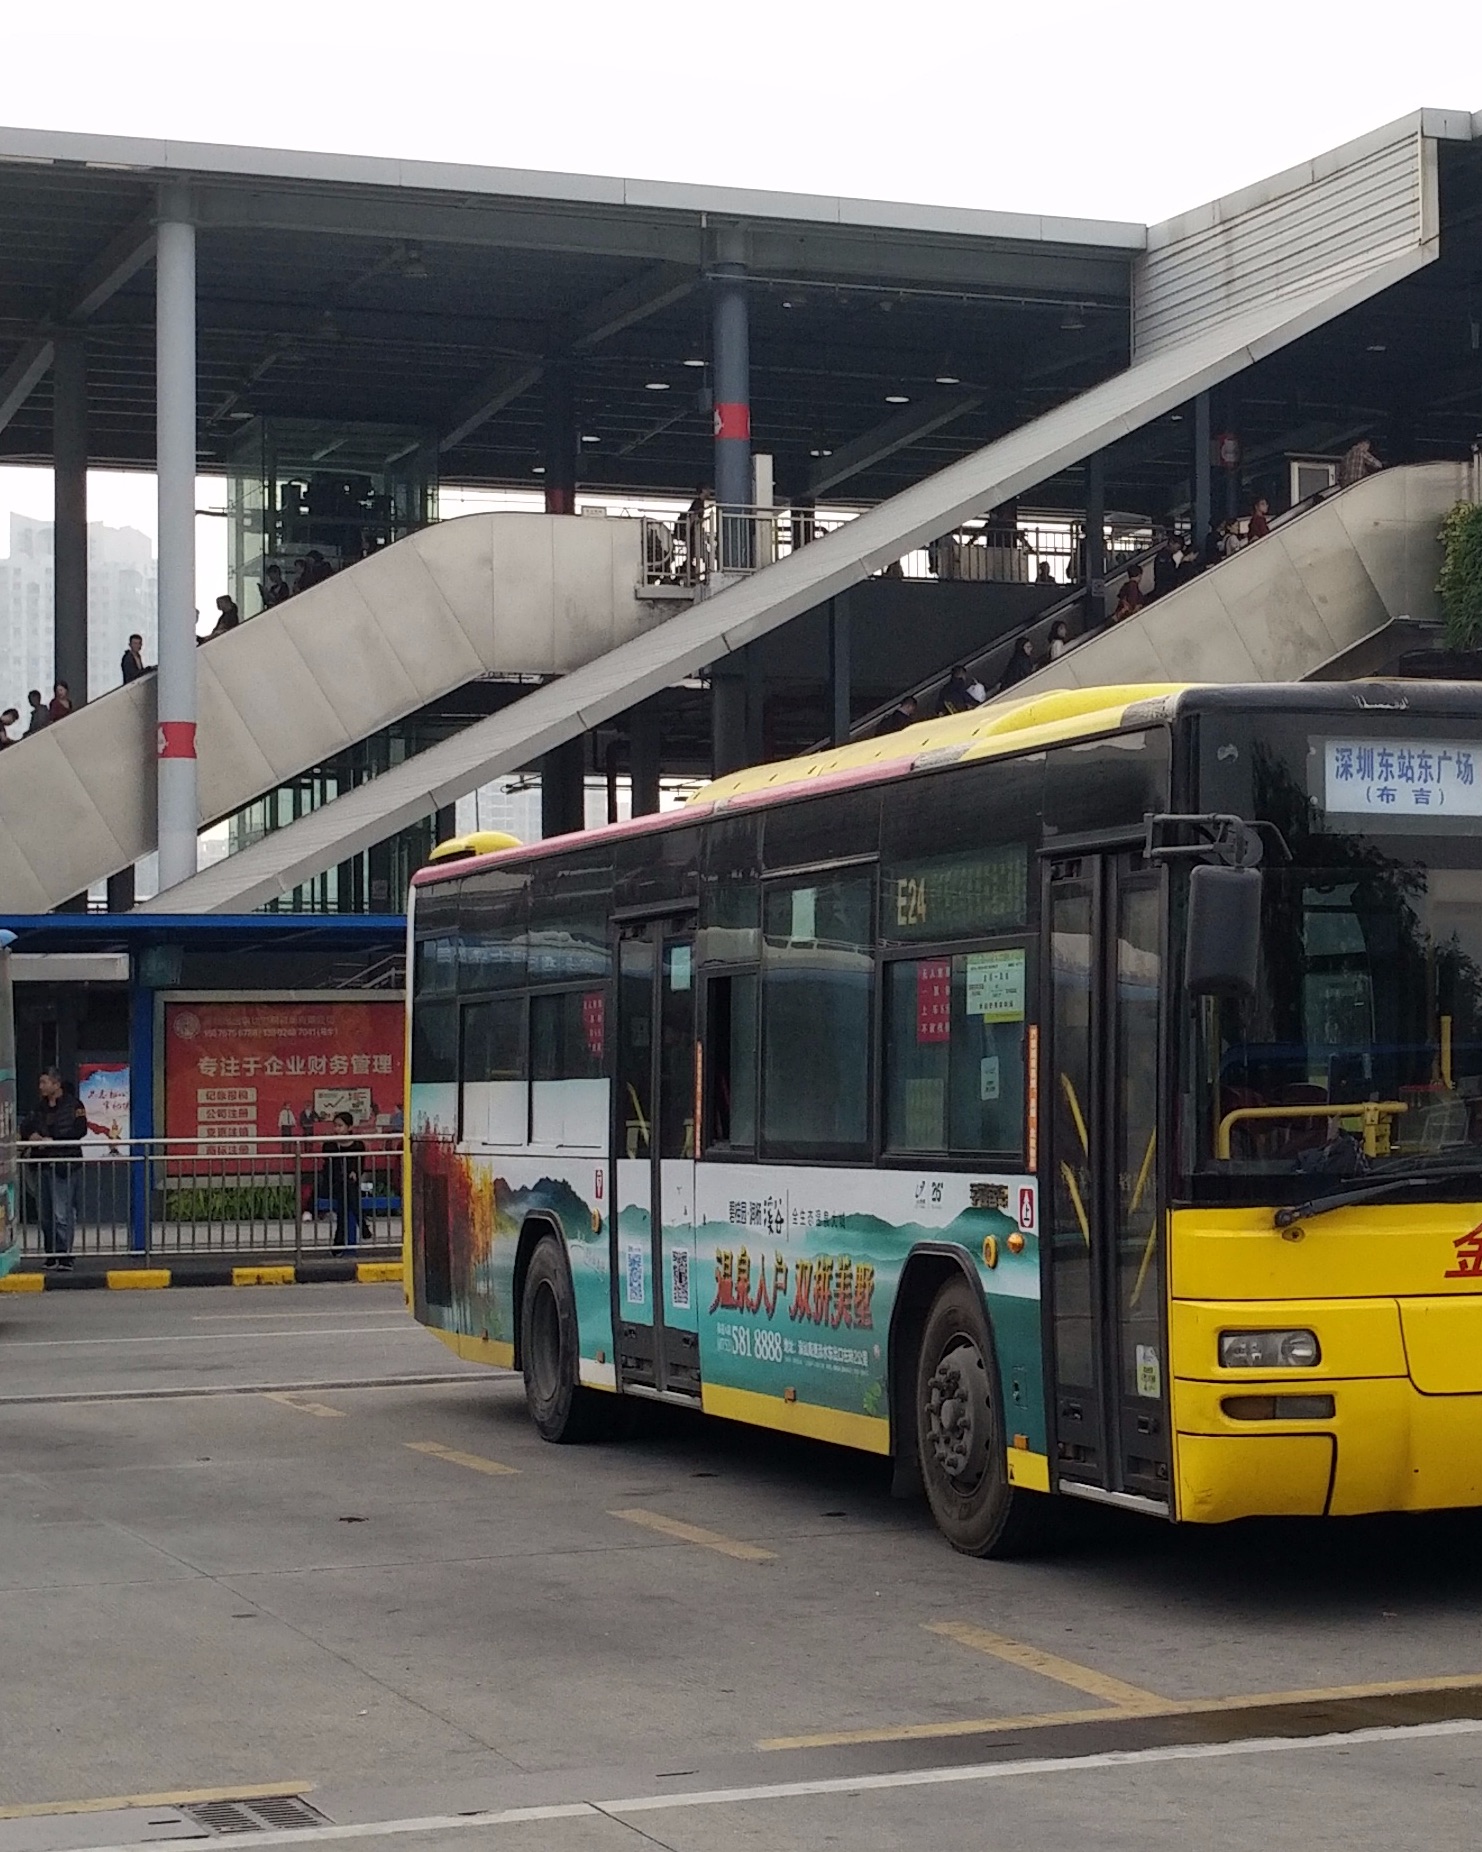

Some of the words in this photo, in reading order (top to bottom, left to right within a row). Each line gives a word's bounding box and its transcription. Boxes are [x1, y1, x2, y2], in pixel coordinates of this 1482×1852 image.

[1334, 746, 1475, 786] 深圳东站东广场
[896, 877, 927, 926] E24
[197, 1053, 393, 1077] 专注于企业财务管理
[731, 1325, 752, 1357] 581
[753, 1329, 783, 1363] 8888
